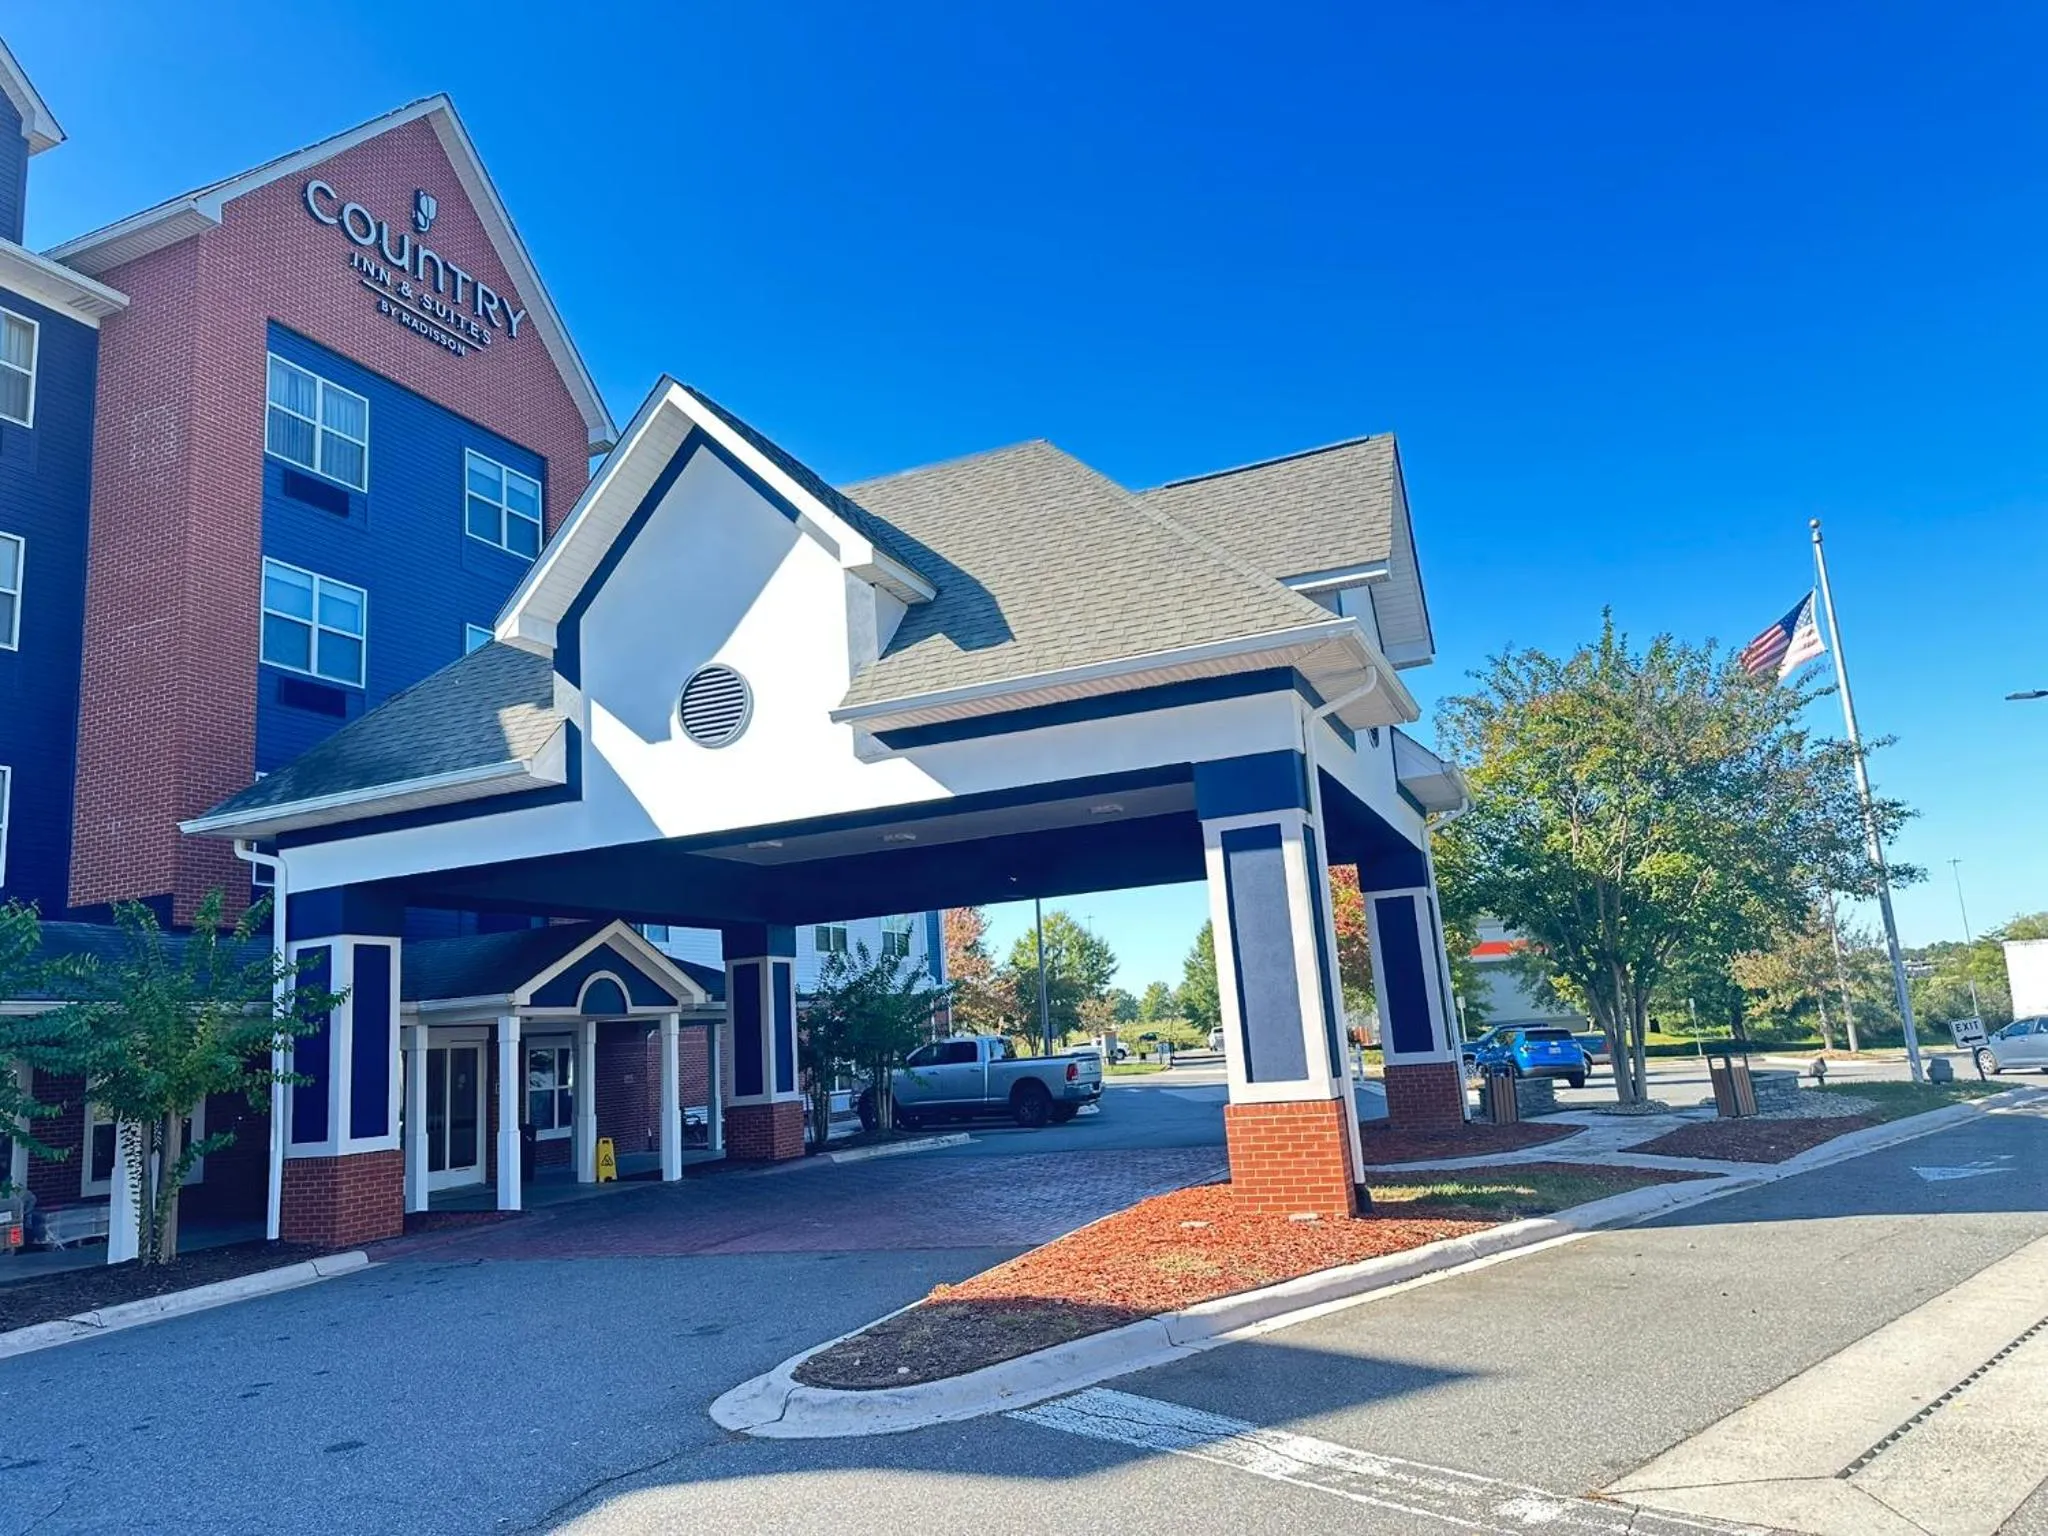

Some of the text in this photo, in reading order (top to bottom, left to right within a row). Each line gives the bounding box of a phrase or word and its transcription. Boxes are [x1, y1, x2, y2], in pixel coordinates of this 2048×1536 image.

[351, 252, 491, 345] INN & SUITES
[380, 300, 466, 355] BY RADISSON
[1955, 1021, 1979, 1033] EXIT
